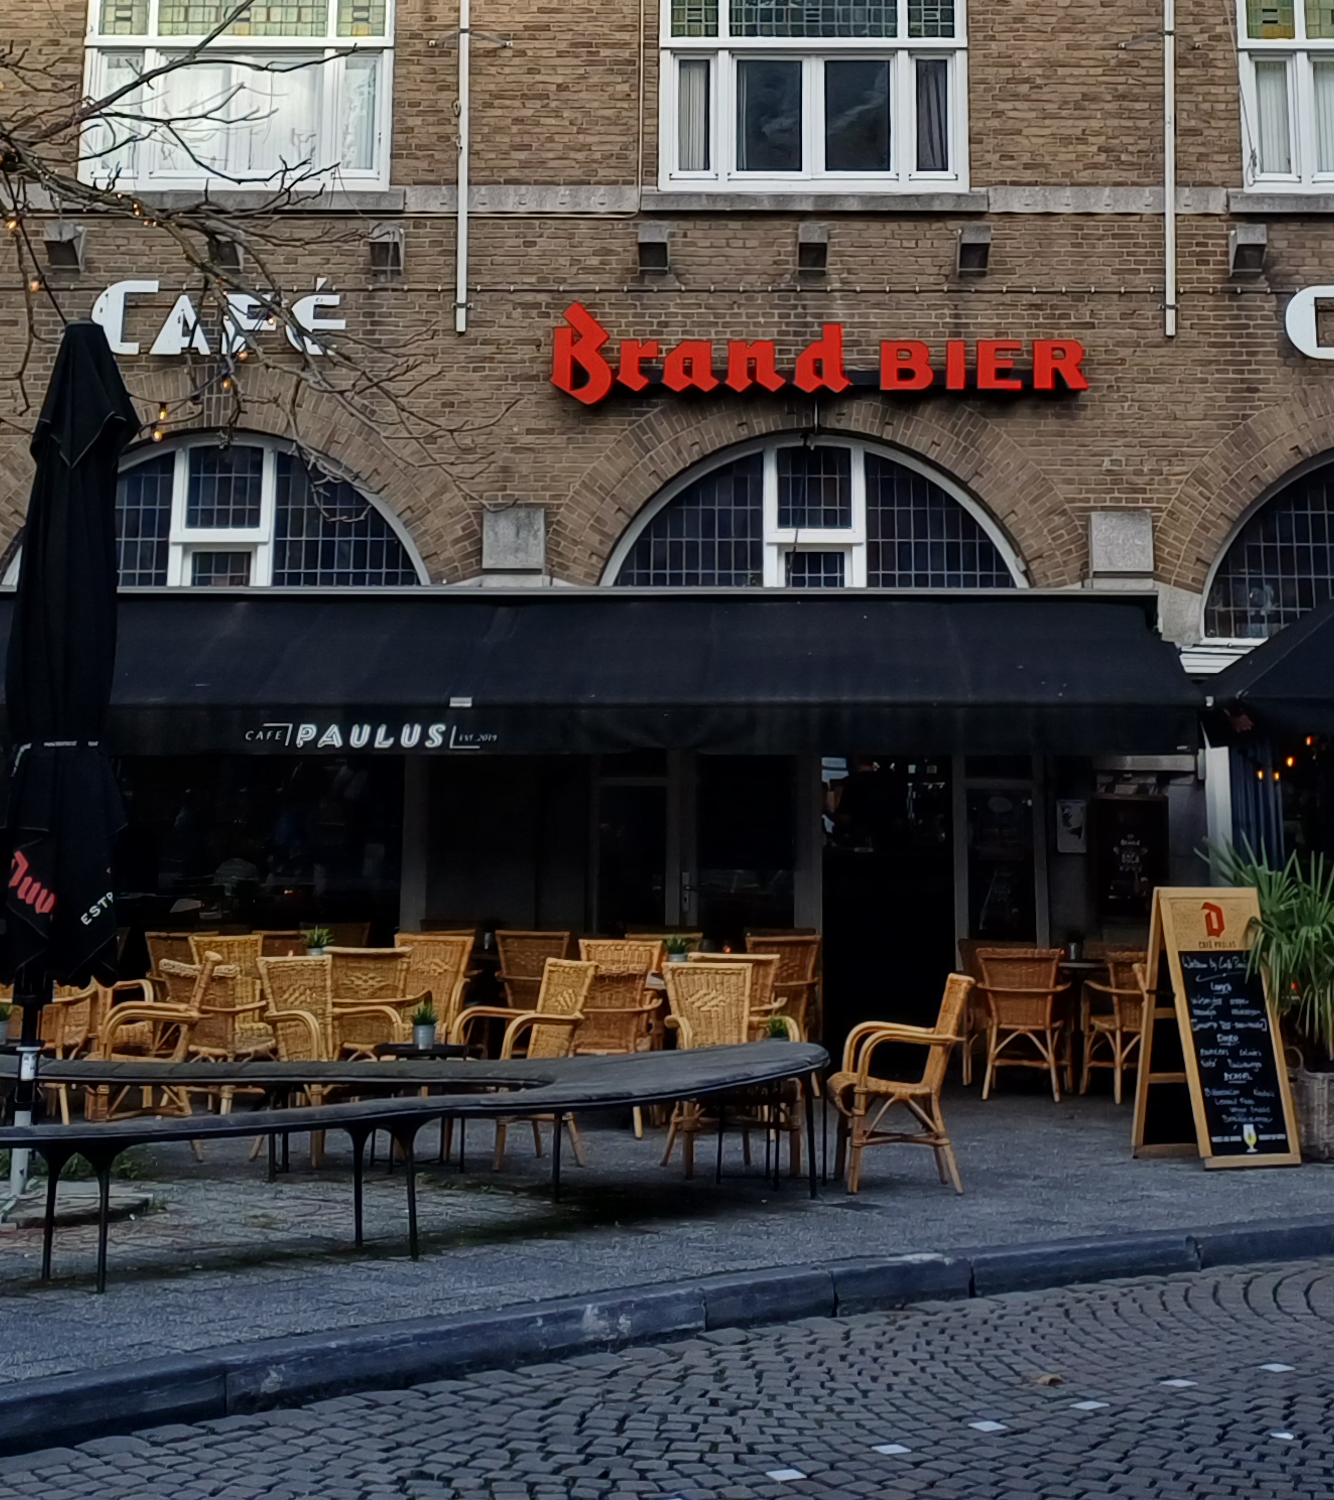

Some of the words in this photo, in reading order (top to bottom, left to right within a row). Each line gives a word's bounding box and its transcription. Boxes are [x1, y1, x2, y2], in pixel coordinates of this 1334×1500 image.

[90, 277, 347, 356] CAFÉ
[549, 301, 852, 405] Brand
[878, 338, 1091, 391] BIER
[295, 722, 447, 750] PAULUS
